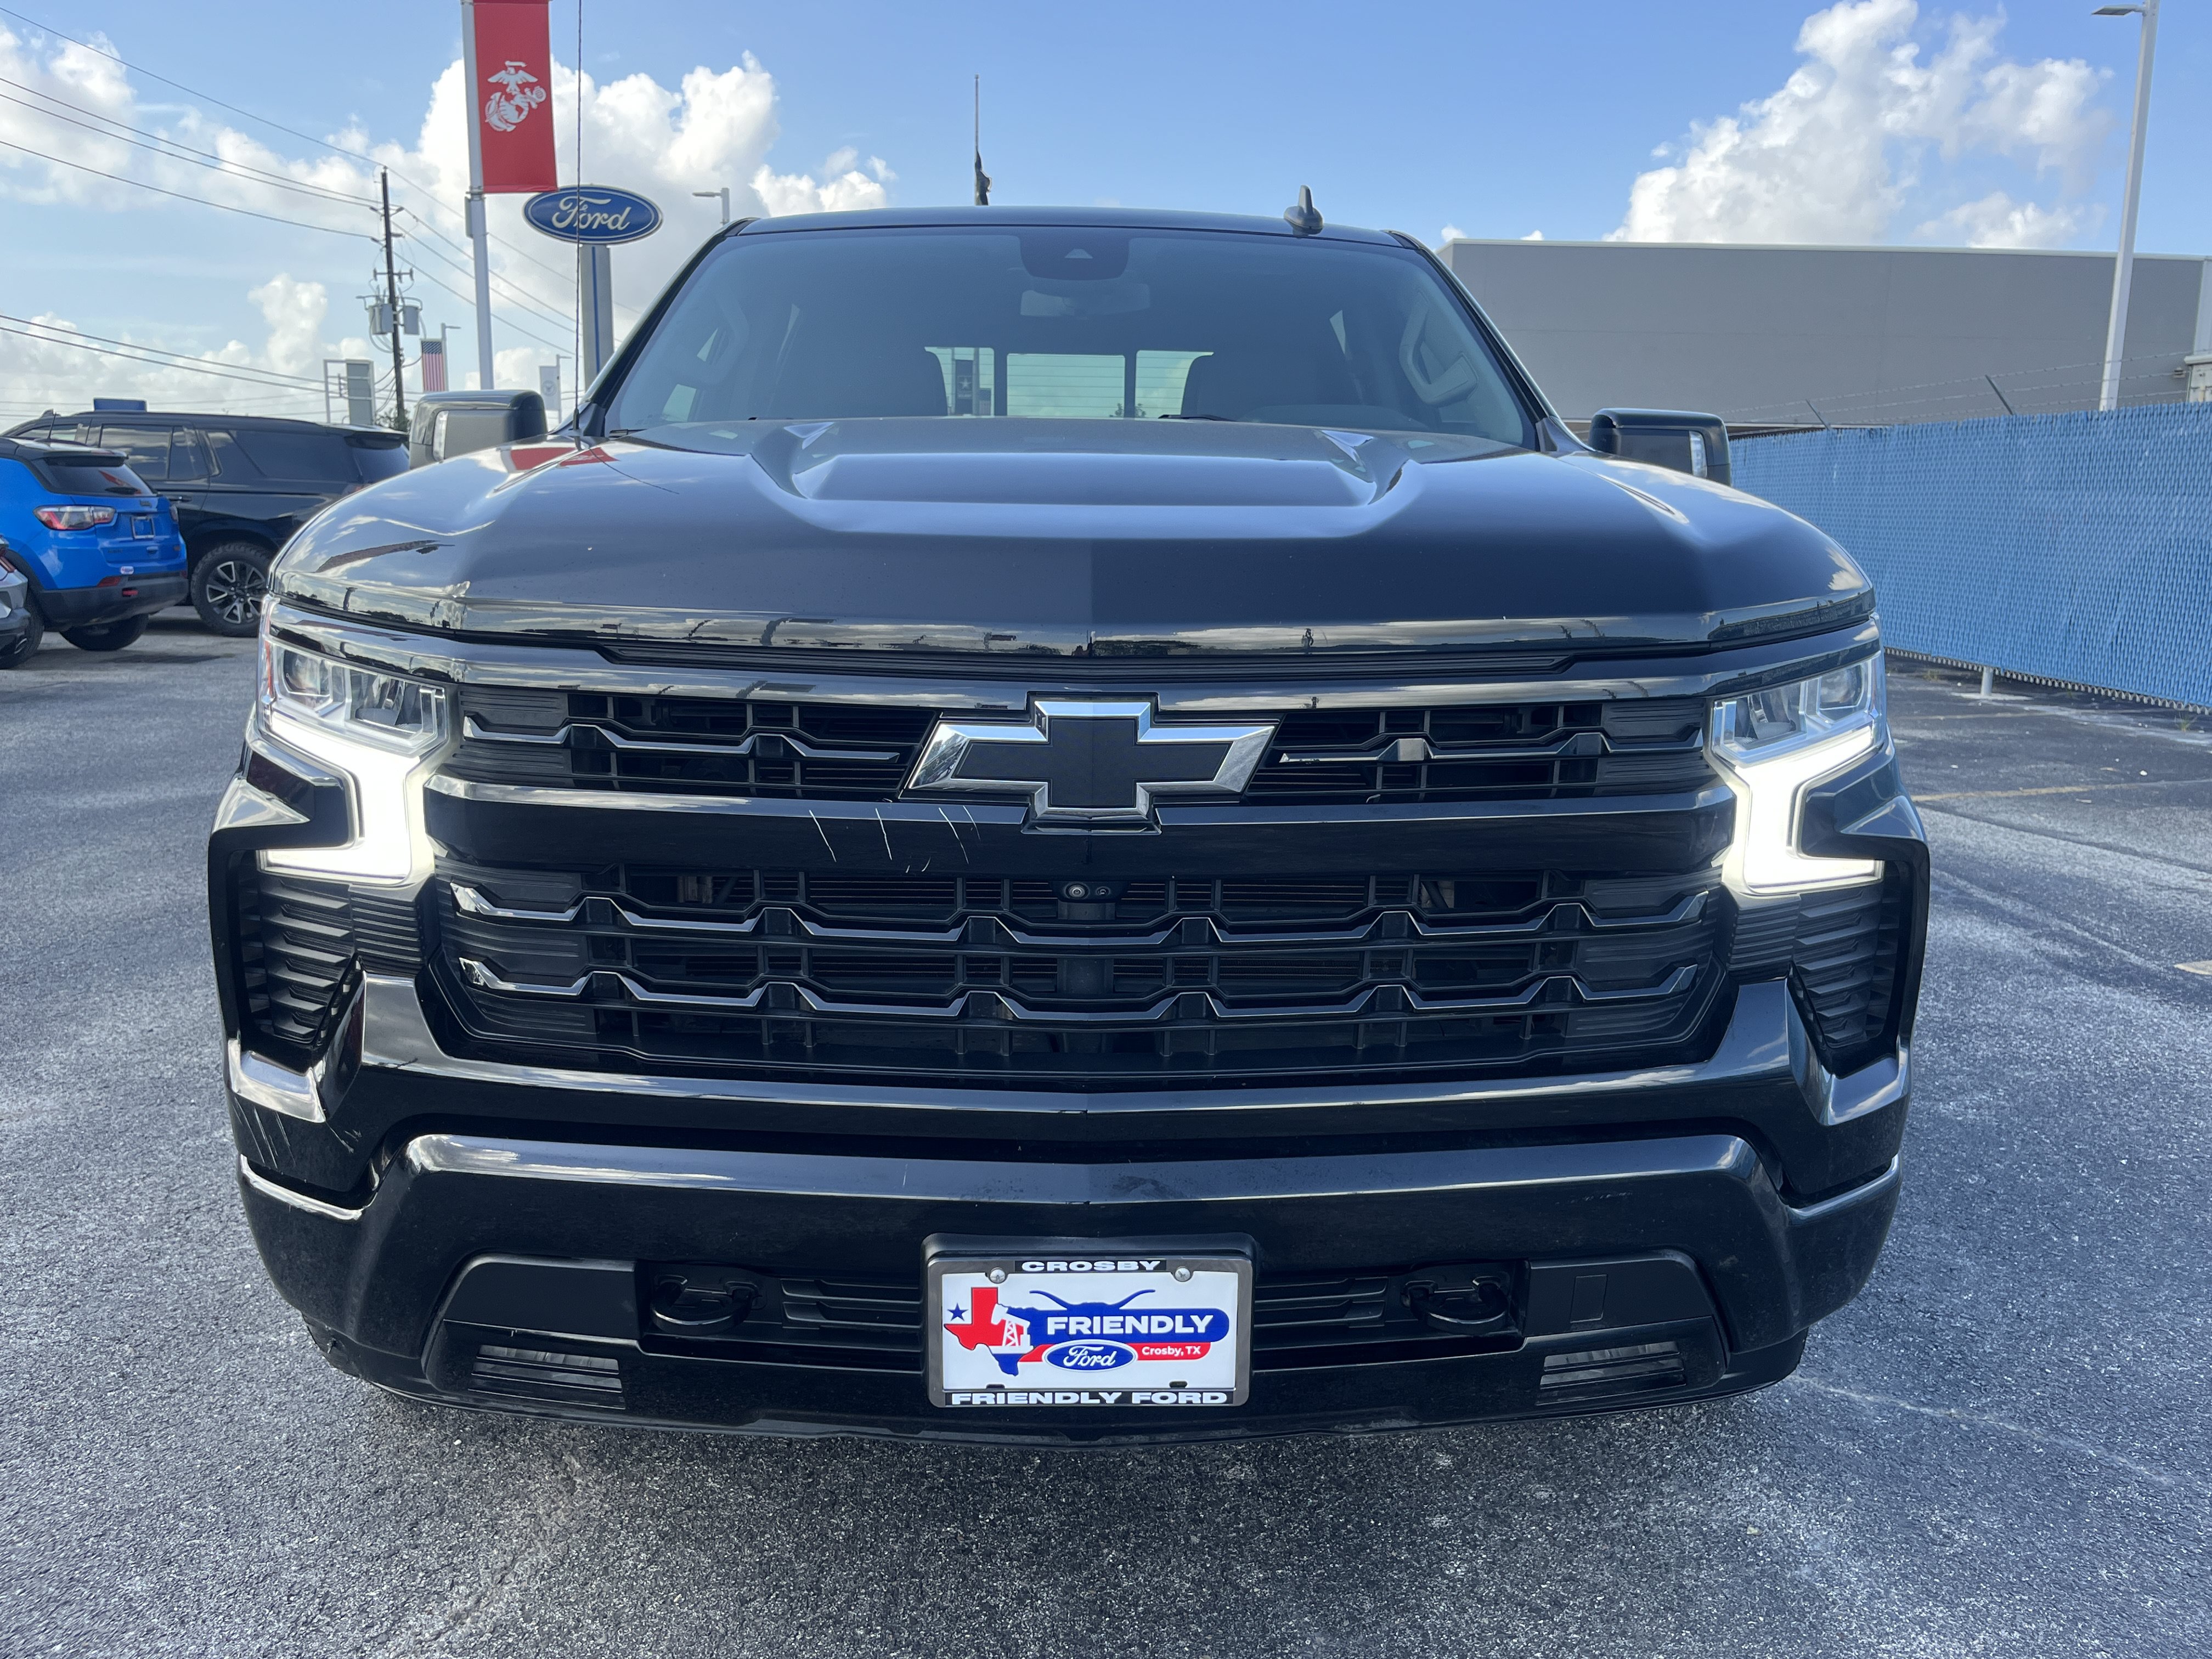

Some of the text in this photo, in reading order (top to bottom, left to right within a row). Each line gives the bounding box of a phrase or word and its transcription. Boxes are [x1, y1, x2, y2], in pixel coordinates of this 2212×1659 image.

[551, 195, 632, 231] Ford
[1022, 1261, 1161, 1272] CROSBY
[1047, 1315, 1214, 1335] FRIENDLY
[1063, 1345, 1116, 1368] Ford
[1142, 1346, 1201, 1357] Crosby, TX
[951, 1392, 1227, 1405] FRIENDLY FORD
